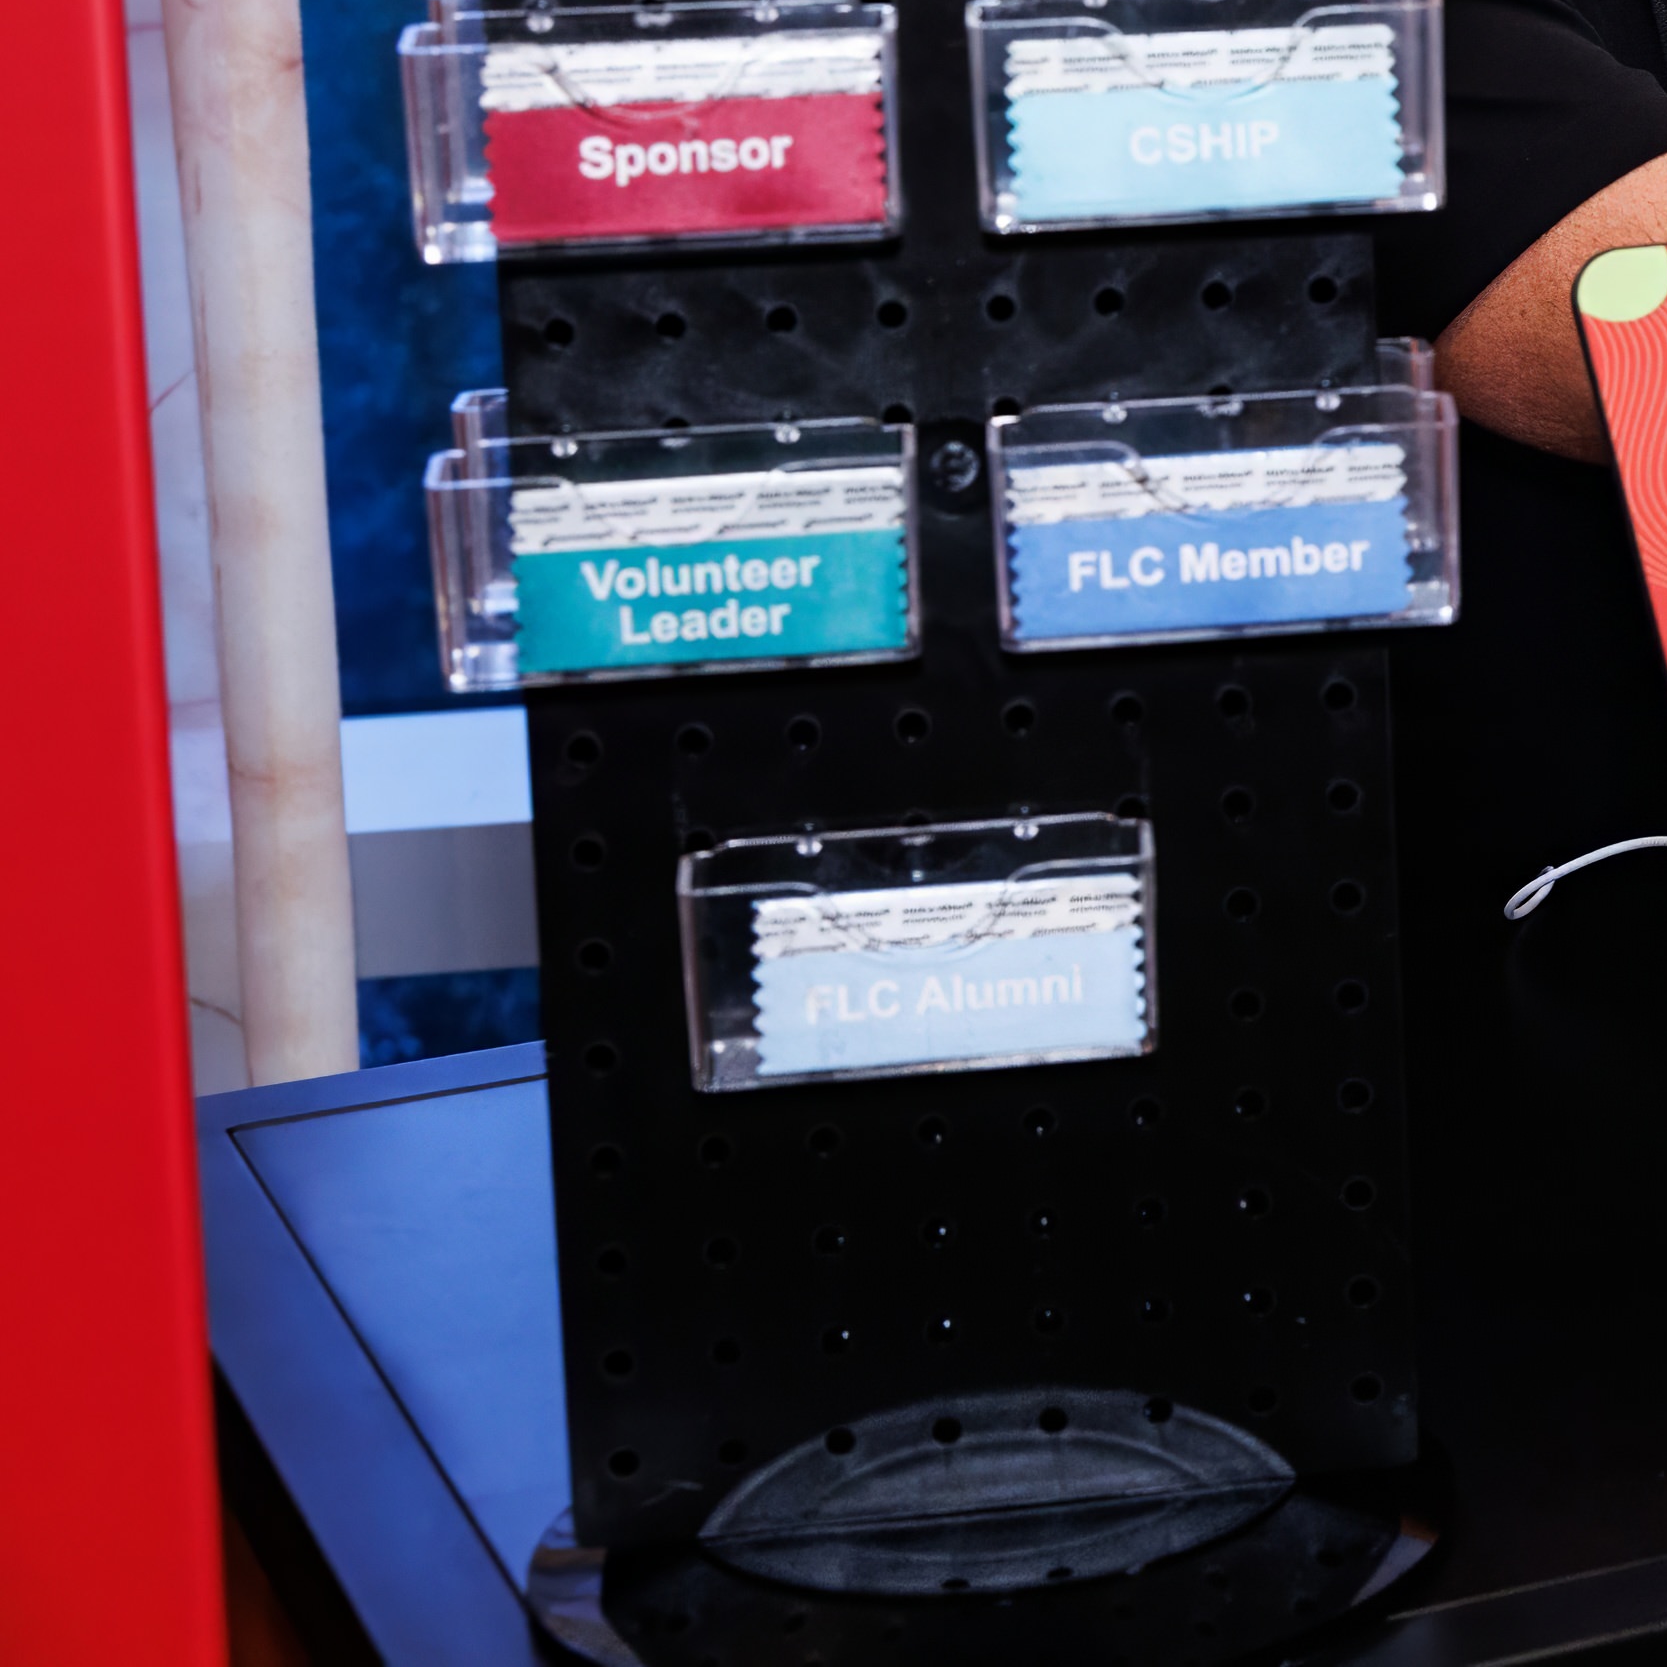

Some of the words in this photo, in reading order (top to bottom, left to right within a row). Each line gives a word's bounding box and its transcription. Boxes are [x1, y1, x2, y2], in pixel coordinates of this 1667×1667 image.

[578, 135, 793, 188] Sponsor
[1128, 120, 1280, 165] CSHIP
[580, 554, 822, 601] Volunteer
[1068, 546, 1166, 593] FLC
[1179, 536, 1371, 584] Member
[619, 599, 791, 645] Leader
[805, 979, 901, 1025] FLC
[916, 964, 1084, 1016] Alumni
